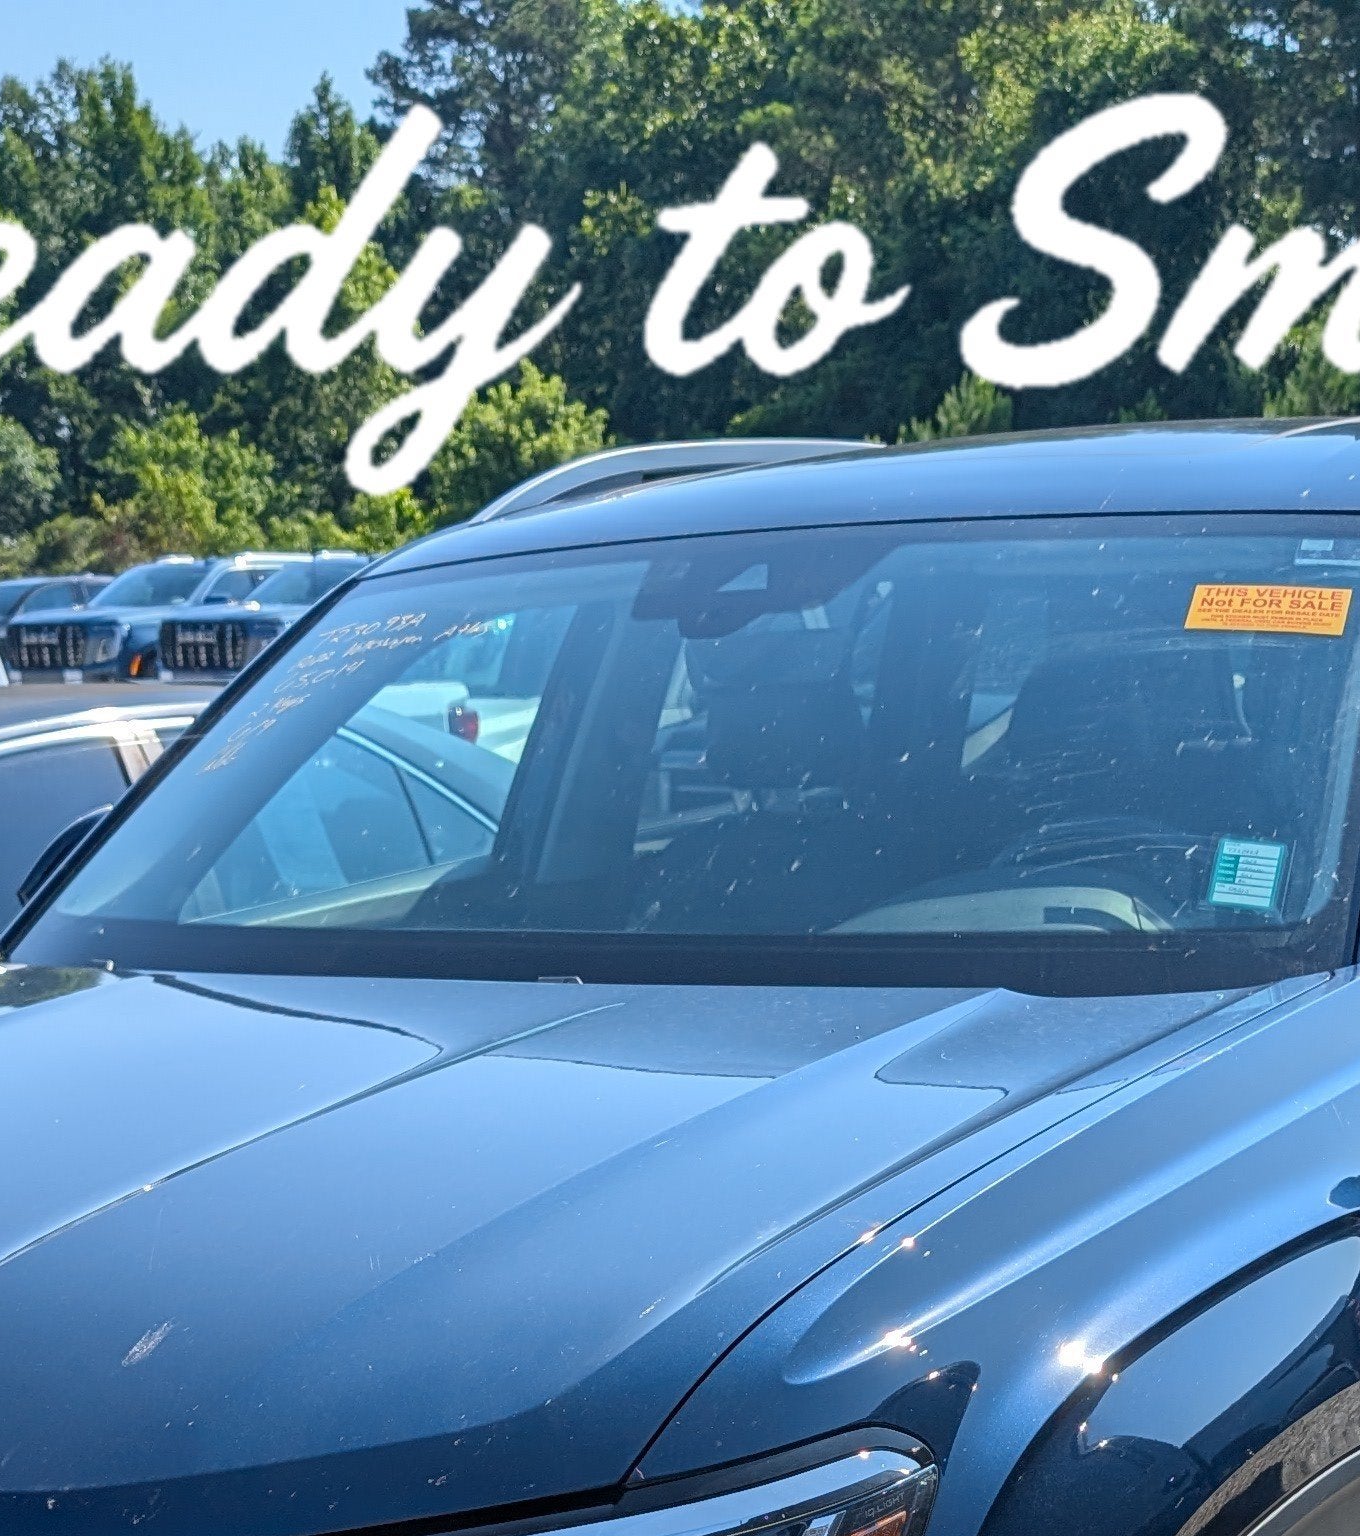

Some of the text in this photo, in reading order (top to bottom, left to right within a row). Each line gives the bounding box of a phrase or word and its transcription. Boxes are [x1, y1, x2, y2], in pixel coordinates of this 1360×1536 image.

[1203, 587, 1344, 600] THIS VEHICLE
[1200, 598, 1343, 611] Not FOR SALE
